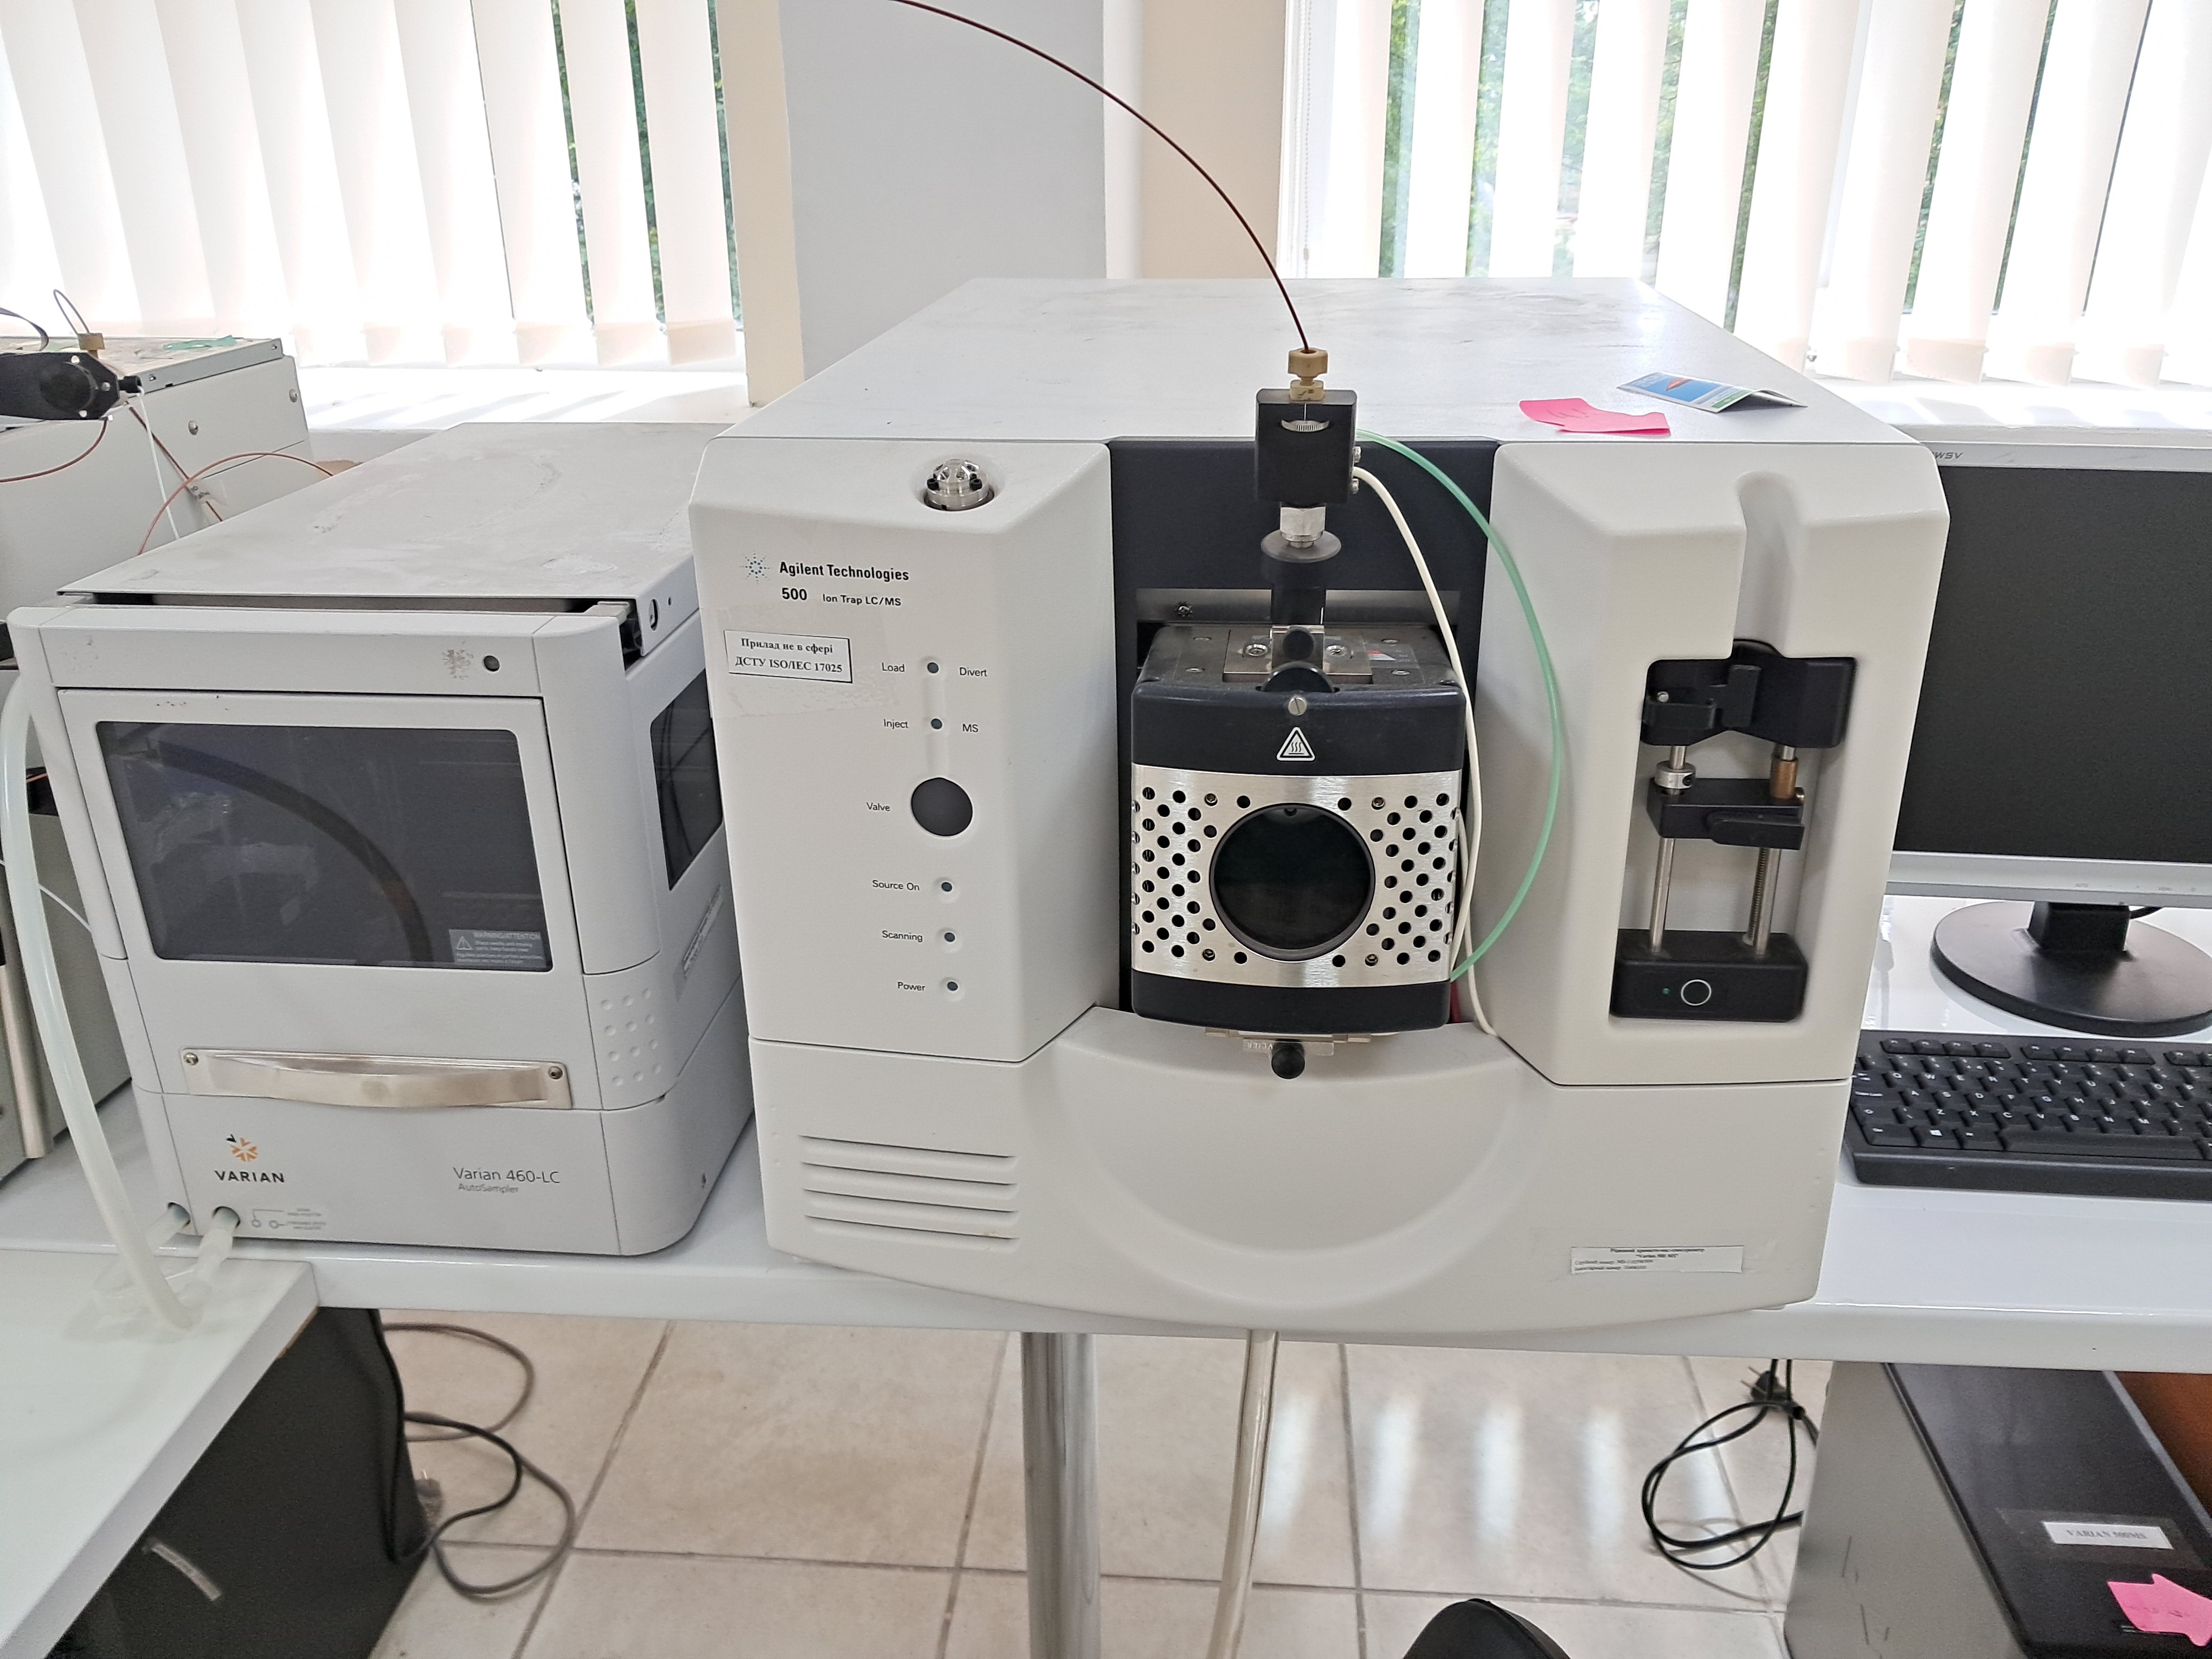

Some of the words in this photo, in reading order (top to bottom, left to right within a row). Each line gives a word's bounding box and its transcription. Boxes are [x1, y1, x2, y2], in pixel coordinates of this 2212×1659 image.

[1931, 451, 1963, 459] WSV
[780, 561, 825, 577] Agilent
[826, 564, 909, 582] Technologies
[782, 587, 807, 600] 500
[823, 594, 838, 602] Ion
[840, 595, 863, 605] Trap
[865, 596, 901, 606] LC/MS
[741, 638, 780, 649] Прилад
[805, 643, 833, 655] сфері
[735, 656, 766, 667] ДСТУ
[814, 663, 843, 673] 17025
[882, 663, 905, 672] Load
[959, 667, 987, 677] Divert
[883, 718, 909, 729] Inject
[962, 723, 979, 732] MS
[866, 802, 891, 812] Valve
[872, 879, 904, 890] Source
[906, 882, 920, 891] On
[882, 930, 923, 942] Scanning
[897, 981, 925, 992] Power
[214, 1170, 285, 1182] VARIAN
[453, 1167, 501, 1180] Varian
[506, 1170, 560, 1184] 460-LC
[459, 1184, 519, 1193] AutoSampler
[2066, 1529, 2111, 1538] VARIAN
